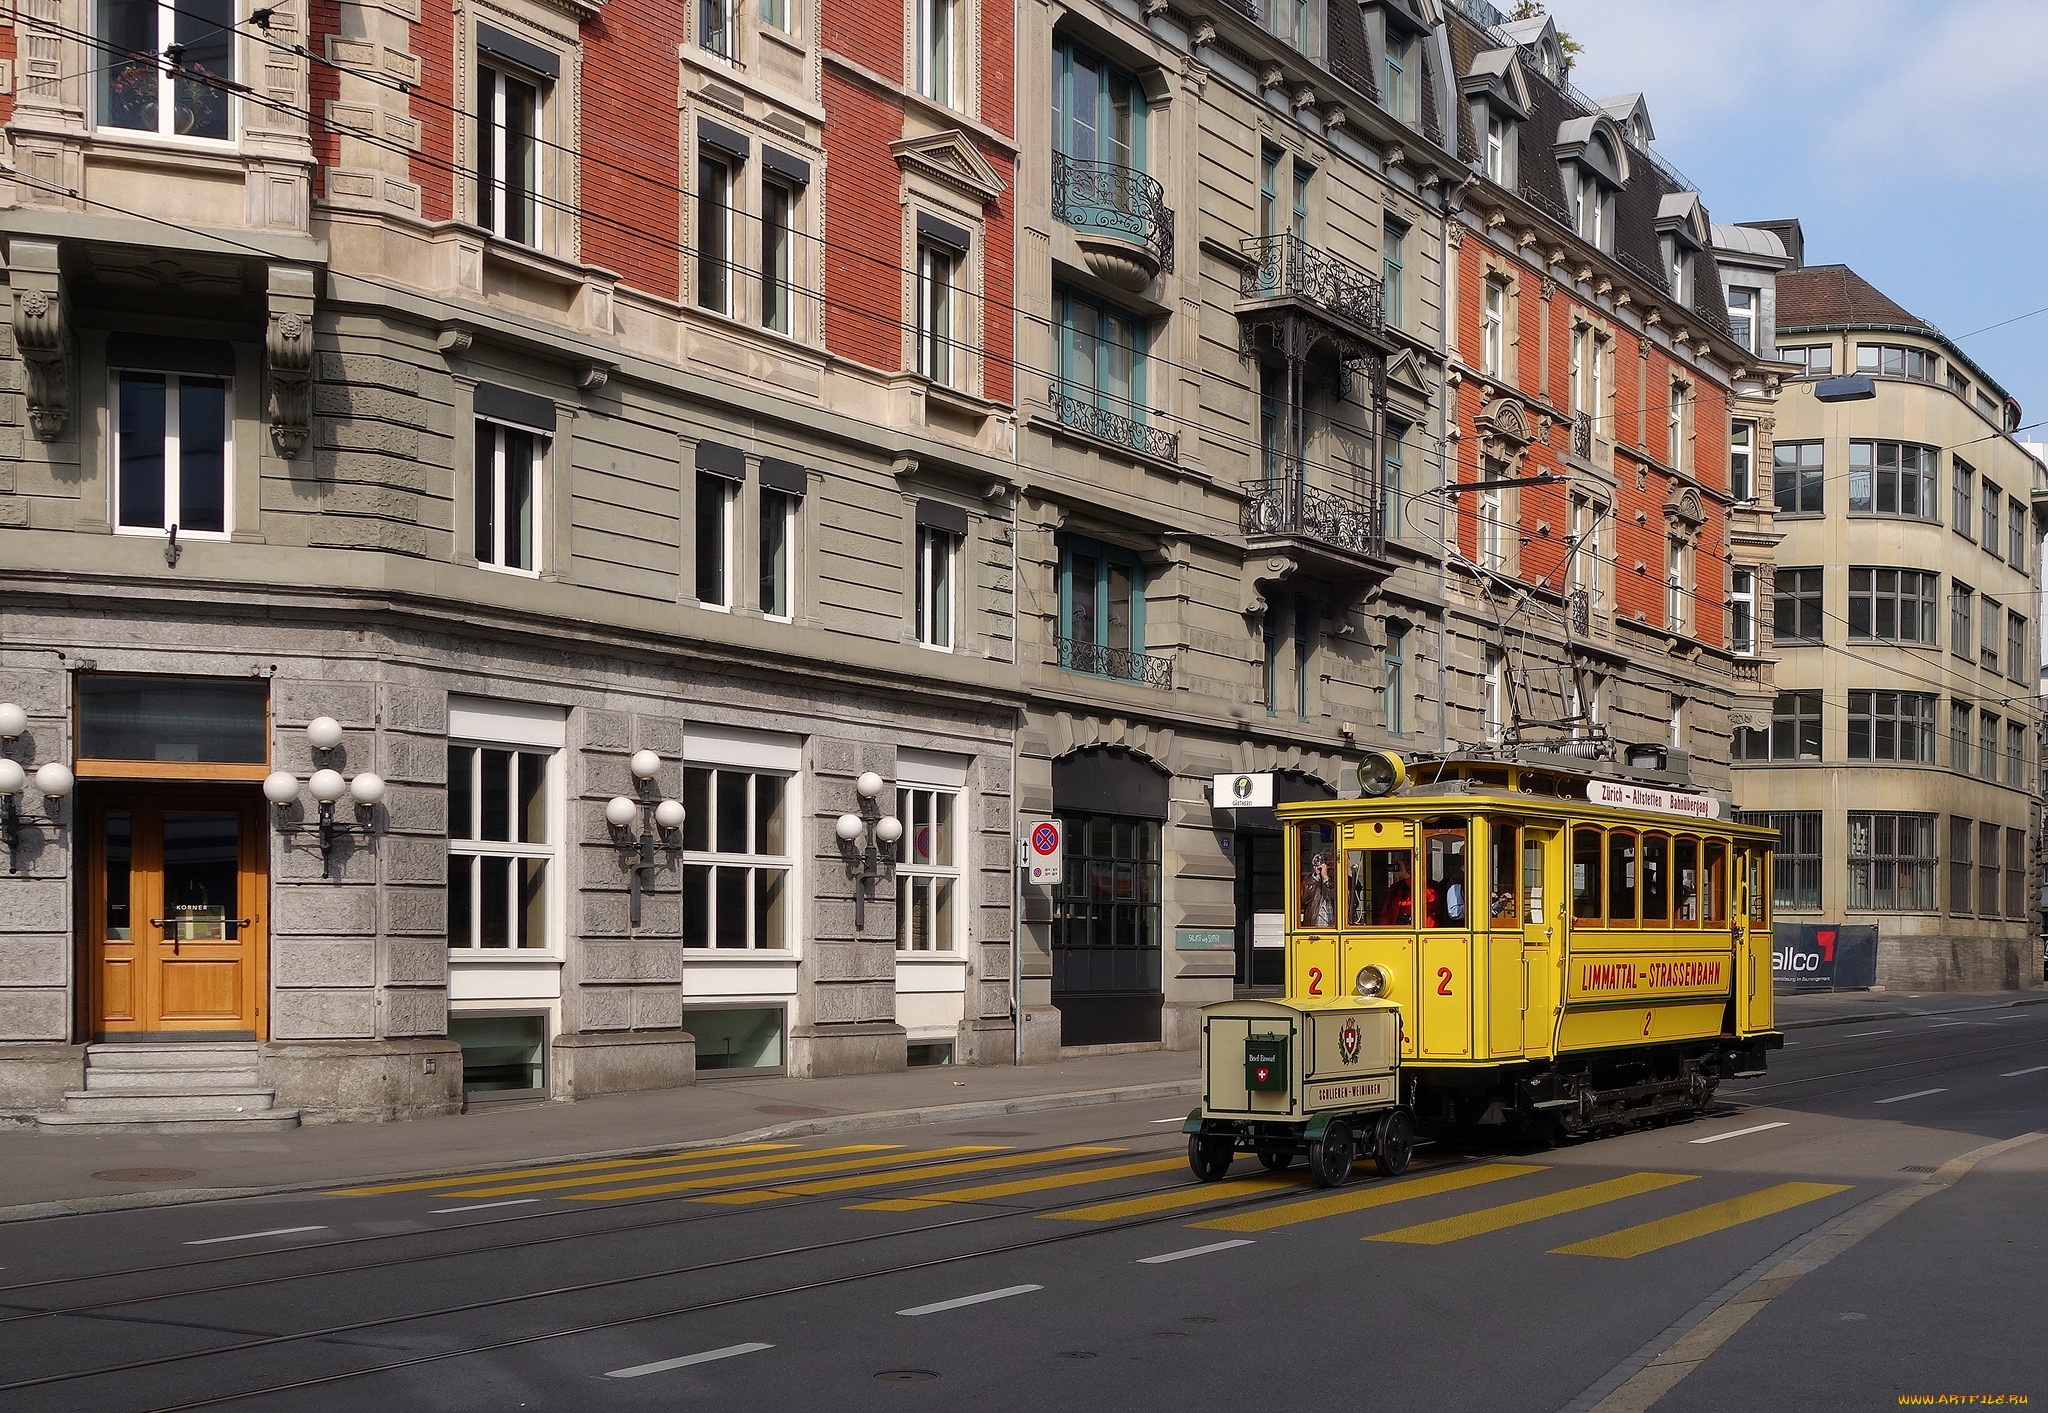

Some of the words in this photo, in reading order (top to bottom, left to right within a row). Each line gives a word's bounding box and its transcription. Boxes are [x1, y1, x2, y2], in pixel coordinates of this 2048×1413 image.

[1602, 785, 1623, 802] Zürich
[1632, 789, 1663, 808] Altstetten
[1669, 794, 1709, 817] Bahnübergang
[1309, 967, 1322, 996] 2
[1437, 967, 1453, 996] 2
[1643, 1011, 1652, 1036] 2
